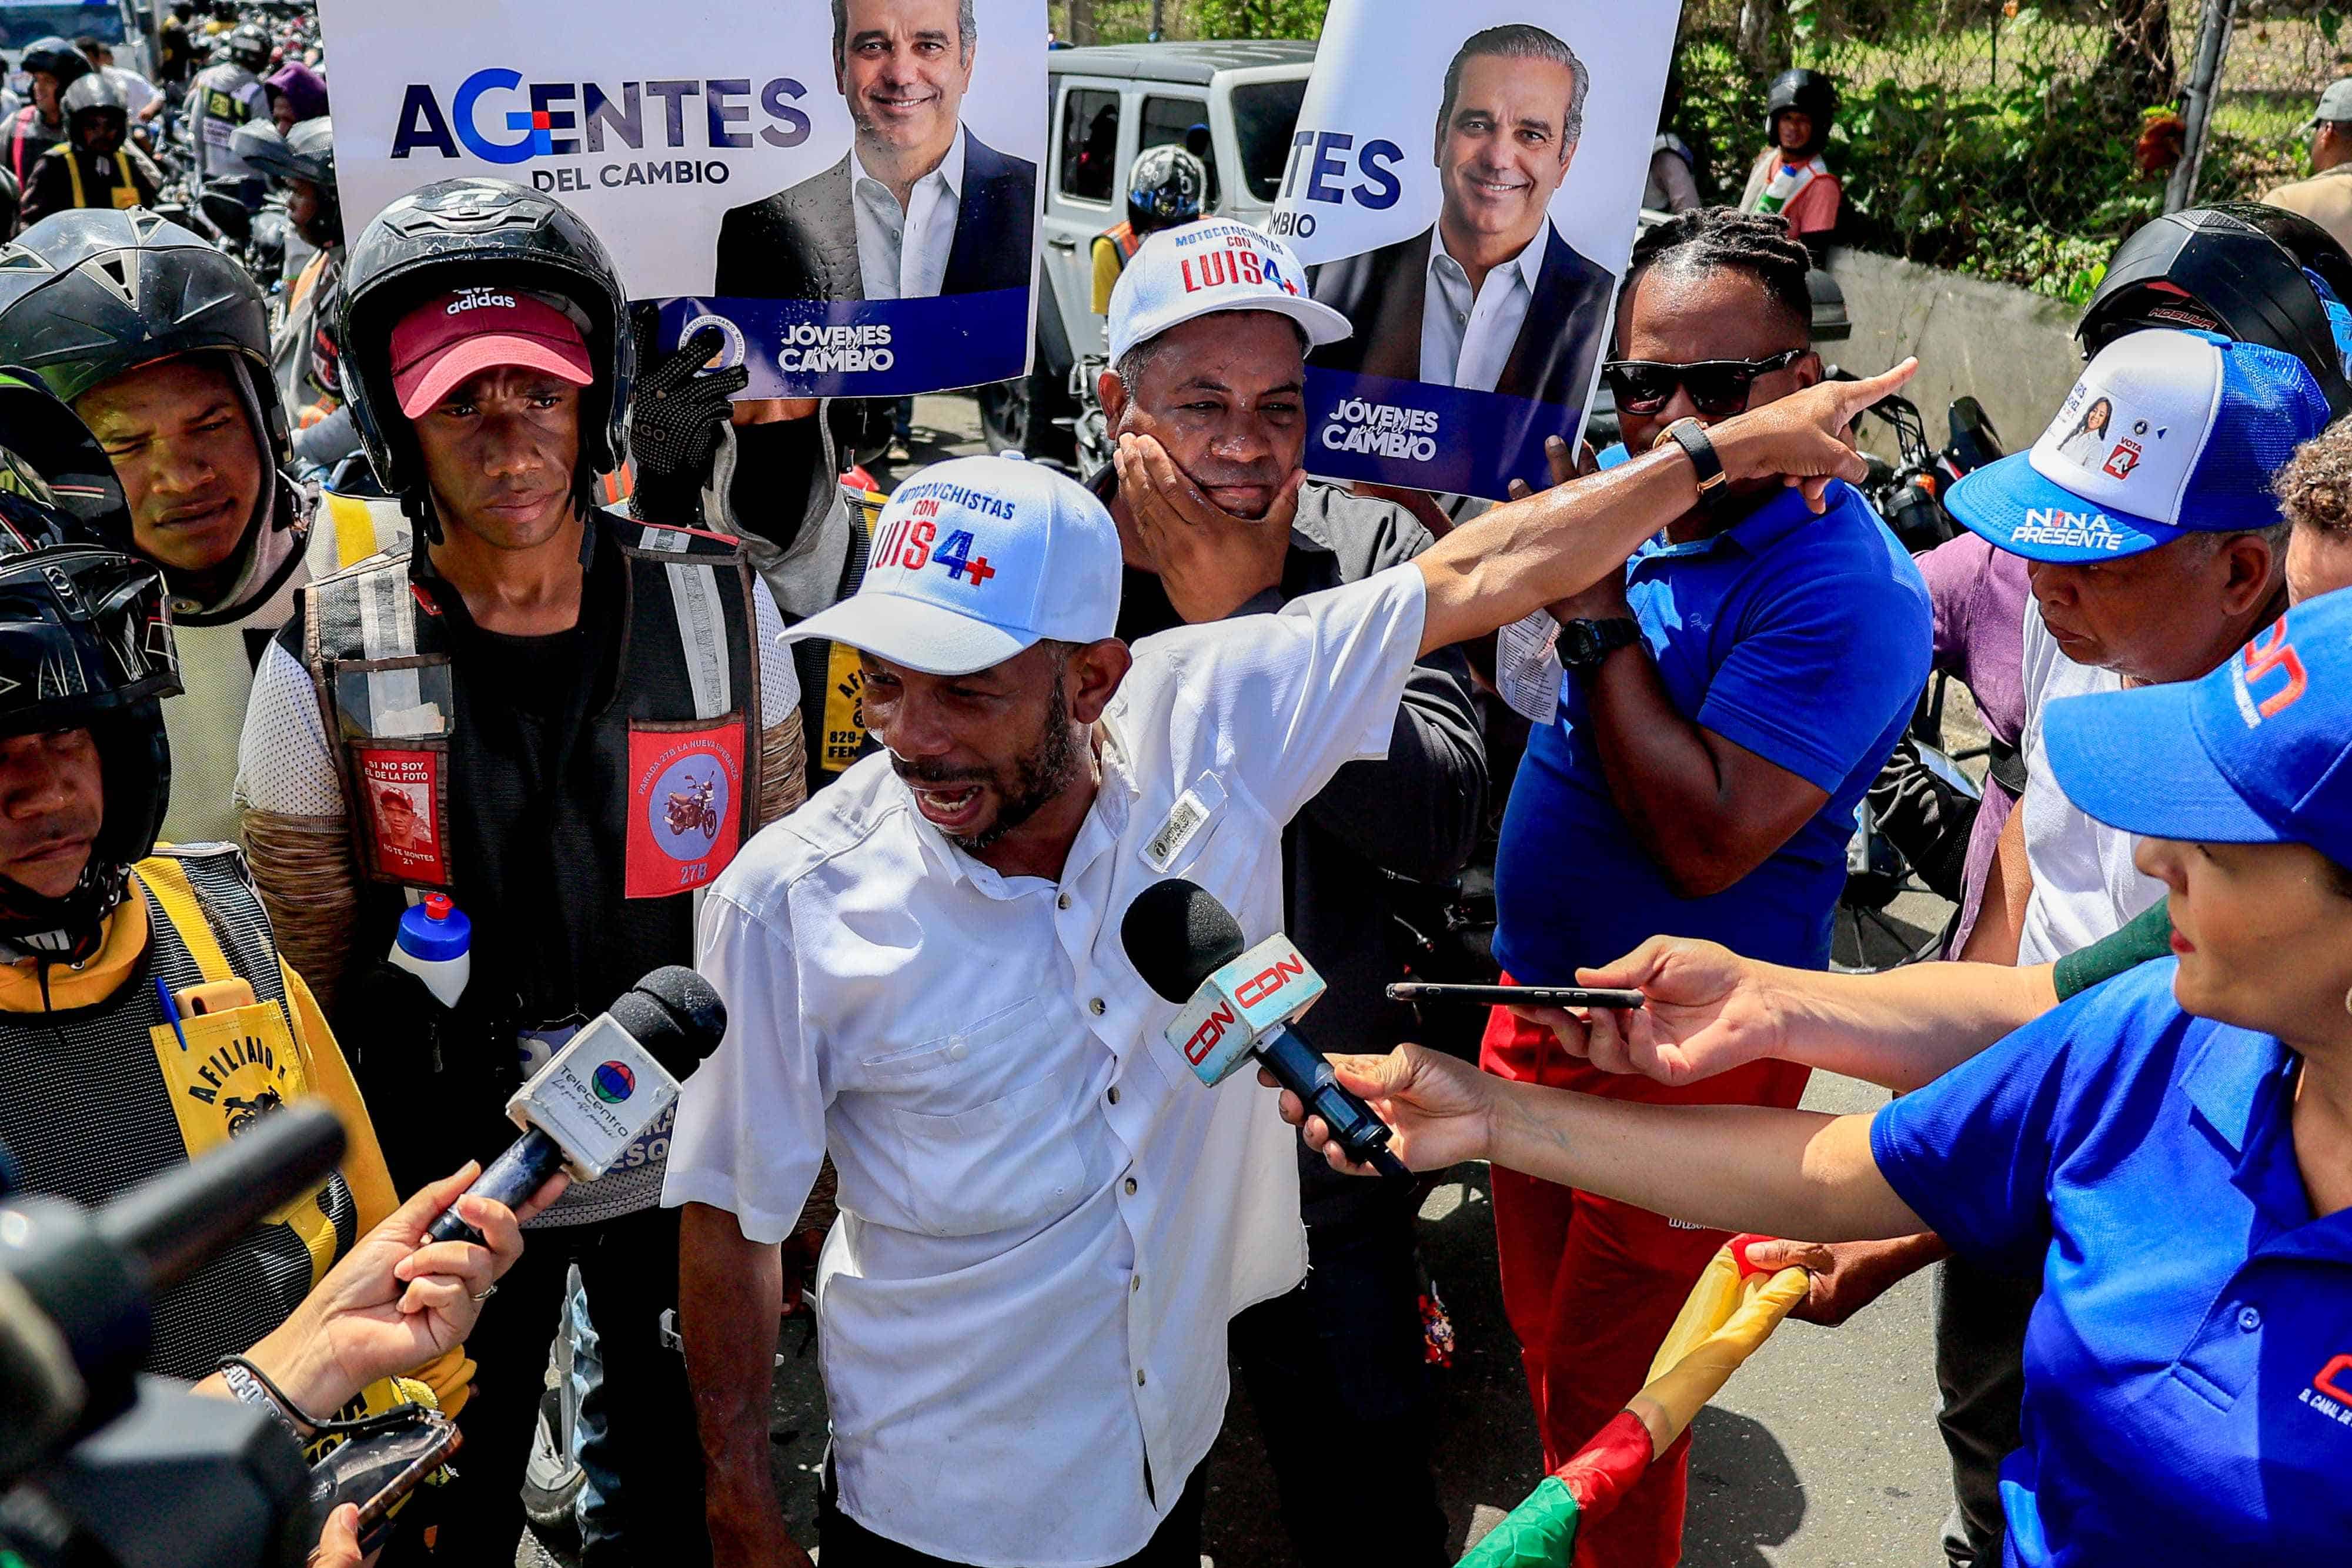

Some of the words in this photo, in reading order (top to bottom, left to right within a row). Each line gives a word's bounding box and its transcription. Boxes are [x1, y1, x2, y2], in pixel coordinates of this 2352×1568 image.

[390, 68, 811, 164] AGENTES
[533, 167, 590, 193] DEL
[600, 160, 730, 186] CAMBIO
[1285, 131, 1404, 210] TES
[1268, 212, 1316, 238] MBIO
[1175, 226, 1284, 255] MOTOCONCHISTAS
[1227, 236, 1252, 249] CON
[447, 293, 516, 315] adidas
[684, 316, 736, 337] REVOLUCIONARIO
[734, 332, 743, 366] MODERNO
[781, 322, 892, 345] JÓVENES
[778, 347, 894, 372] CAMBIO
[1329, 397, 1438, 433] JÓVENES
[1322, 423, 1436, 462] CAMBIO
[2120, 436, 2142, 453] VOTA
[2109, 451, 2133, 474] 4
[897, 482, 1015, 520] MOTOCONCHISTAS
[913, 499, 940, 517] CON
[2010, 526, 2123, 551] PRESENTE
[365, 767, 374, 777] EL
[375, 770, 386, 779] DE
[389, 772, 400, 781] LA
[403, 772, 428, 781] FOTO
[369, 761, 377, 769] SI
[381, 763, 397, 771] NO
[401, 763, 424, 771] SOY
[638, 760, 662, 795] PARADA
[660, 748, 676, 763] 27B
[677, 743, 689, 752] LA
[690, 740, 715, 748] NUEVA
[716, 743, 739, 781] ESPERANZA
[383, 843, 393, 852] NO
[393, 847, 403, 856] TE
[404, 850, 435, 862] MONTES
[680, 862, 708, 884] 27B
[1235, 952, 1304, 1009] CDN
[1184, 1001, 1235, 1066] CDN
[188, 1036, 273, 1105] AFILIADO
[559, 1065, 629, 1137] Telecentro
